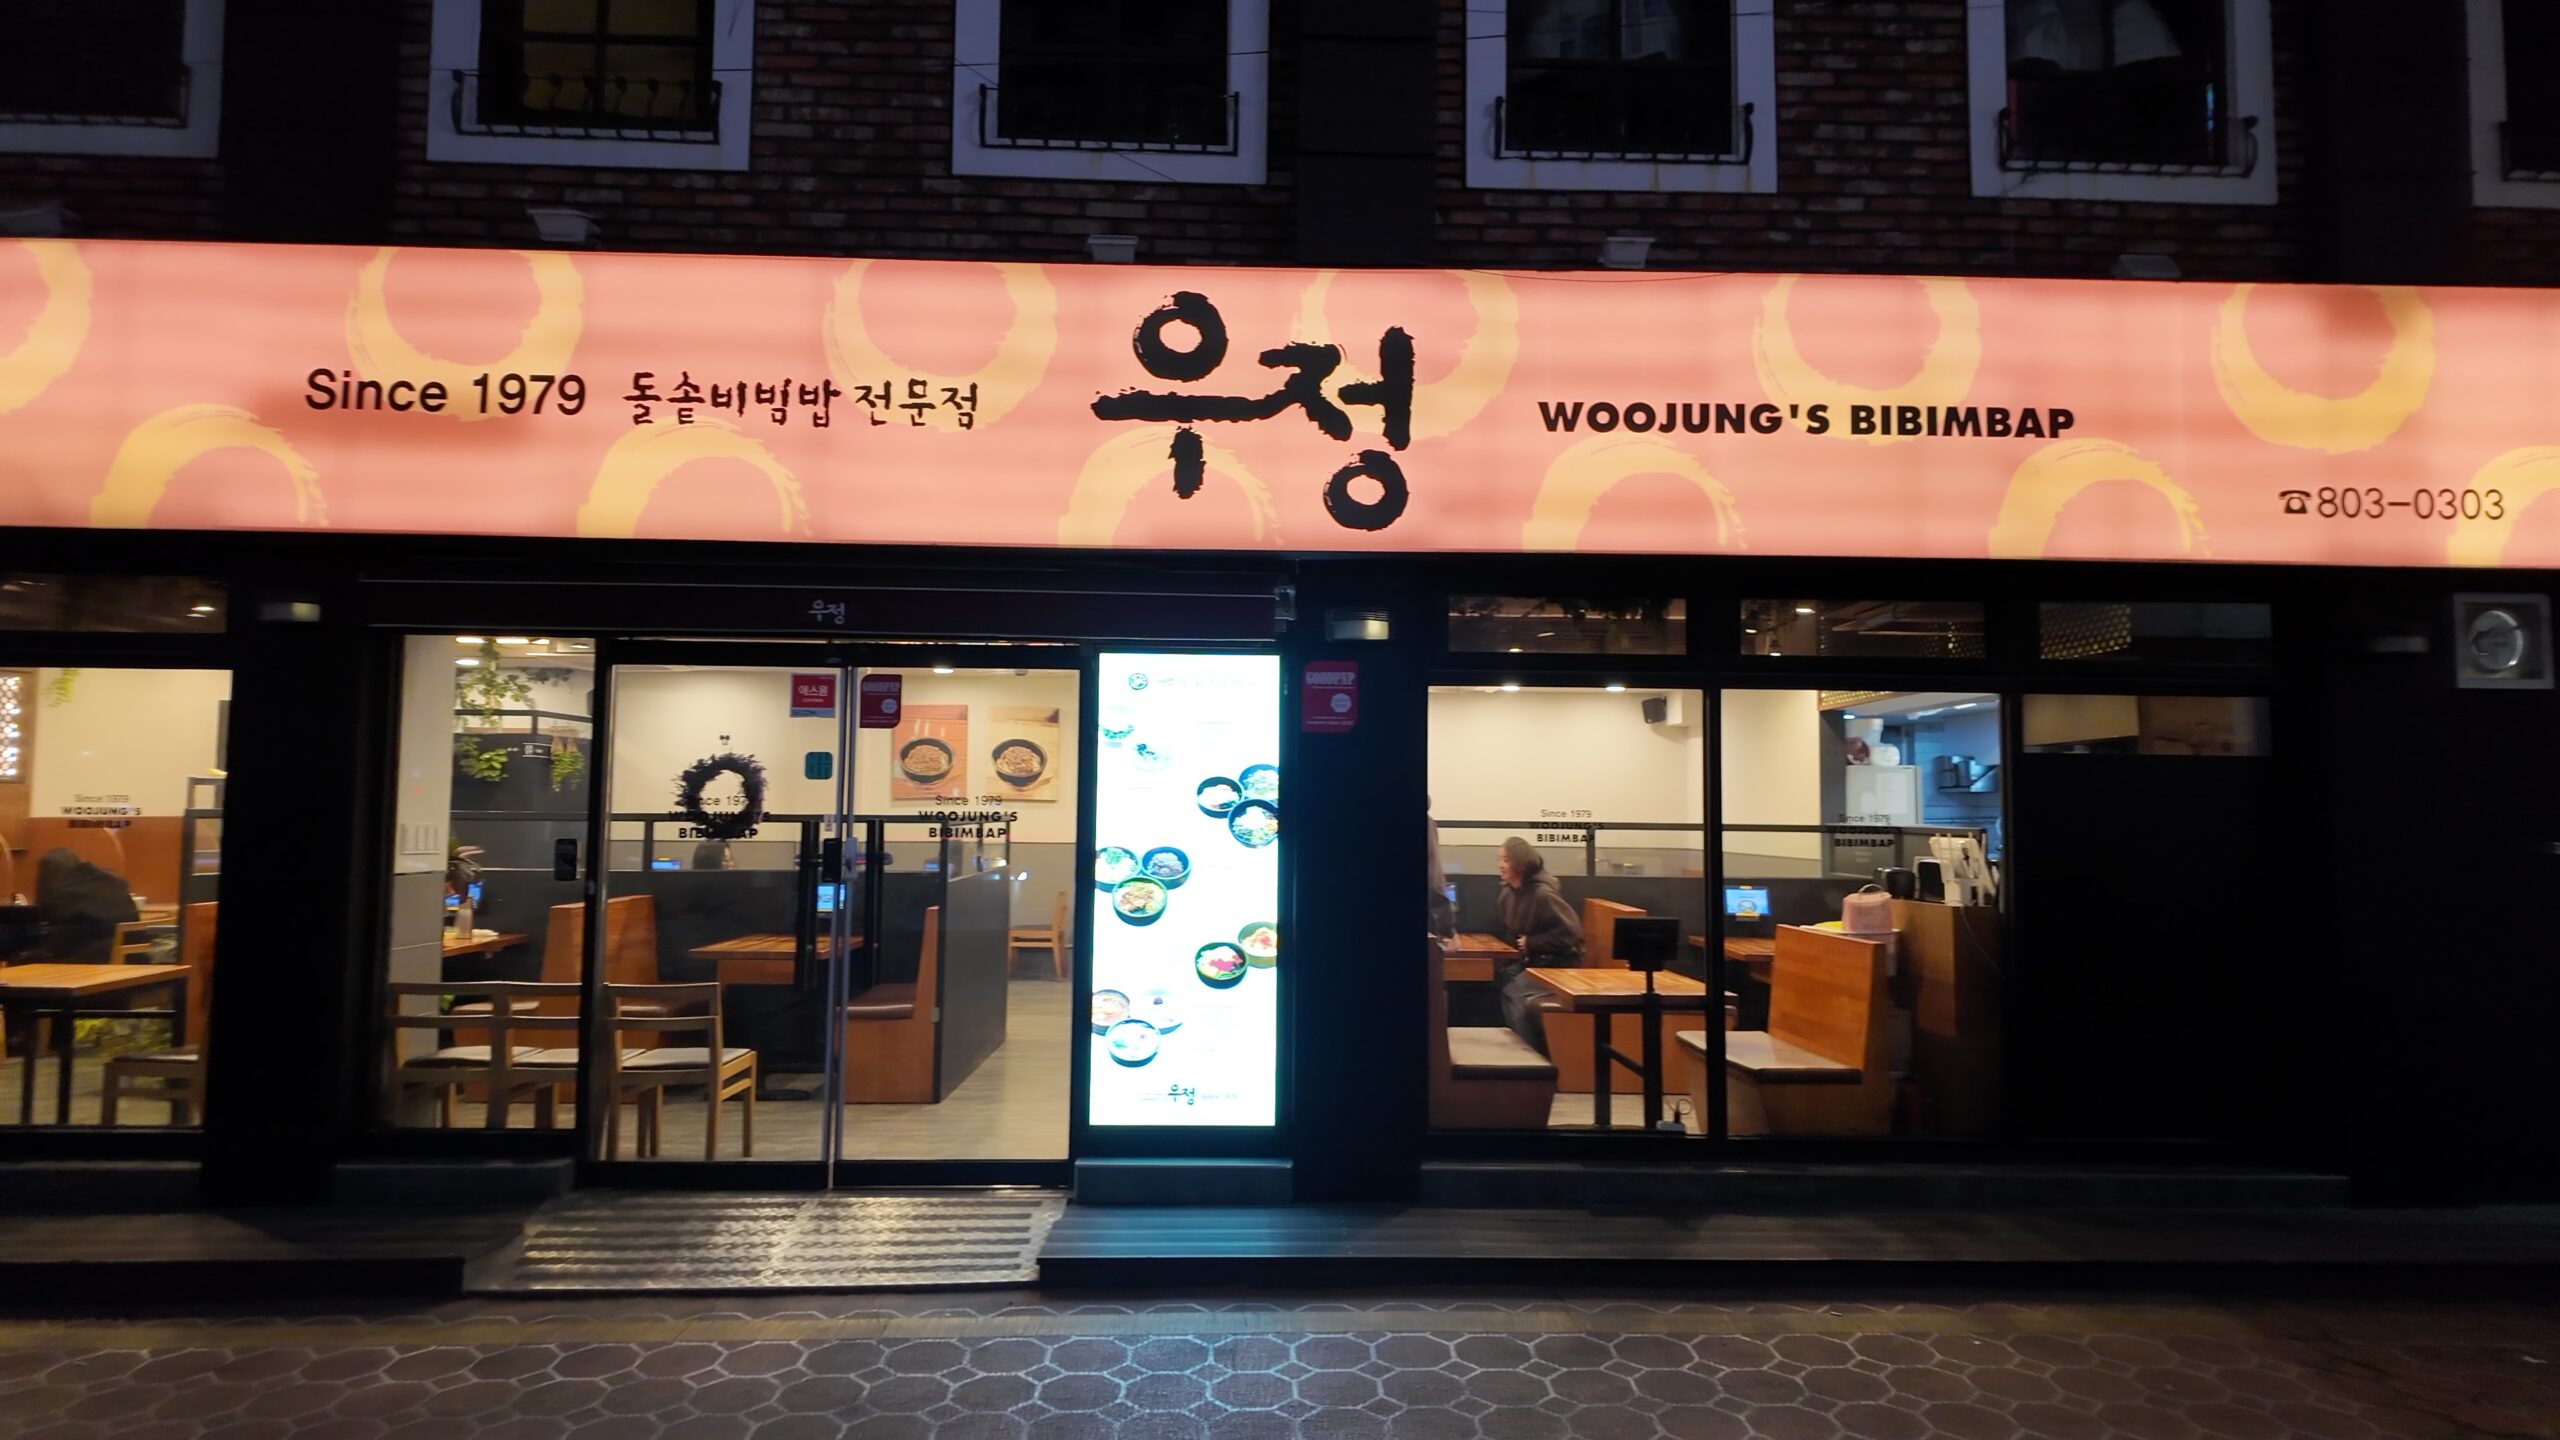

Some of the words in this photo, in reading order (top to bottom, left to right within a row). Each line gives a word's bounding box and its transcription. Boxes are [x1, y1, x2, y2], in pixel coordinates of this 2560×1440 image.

[305, 367, 448, 413] Since
[473, 372, 586, 416] 1979
[622, 371, 842, 428] 돌솥비빔밥
[854, 379, 979, 430] 전문점
[1091, 290, 1415, 531] 우정
[1537, 401, 1831, 435] WOOJUNG'S
[1850, 405, 2076, 440] BIBIMBAP
[2316, 486, 2505, 521] 803-0303
[808, 600, 846, 625] 우정
[935, 795, 969, 806] Since
[975, 795, 1002, 806] 1979
[1540, 808, 1567, 818] Since
[1571, 809, 1592, 818] 1979
[918, 810, 1018, 822] WOOJUNG'S
[929, 827, 1007, 839] BIBIMBAP
[1167, 1083, 1196, 1106] 우정
